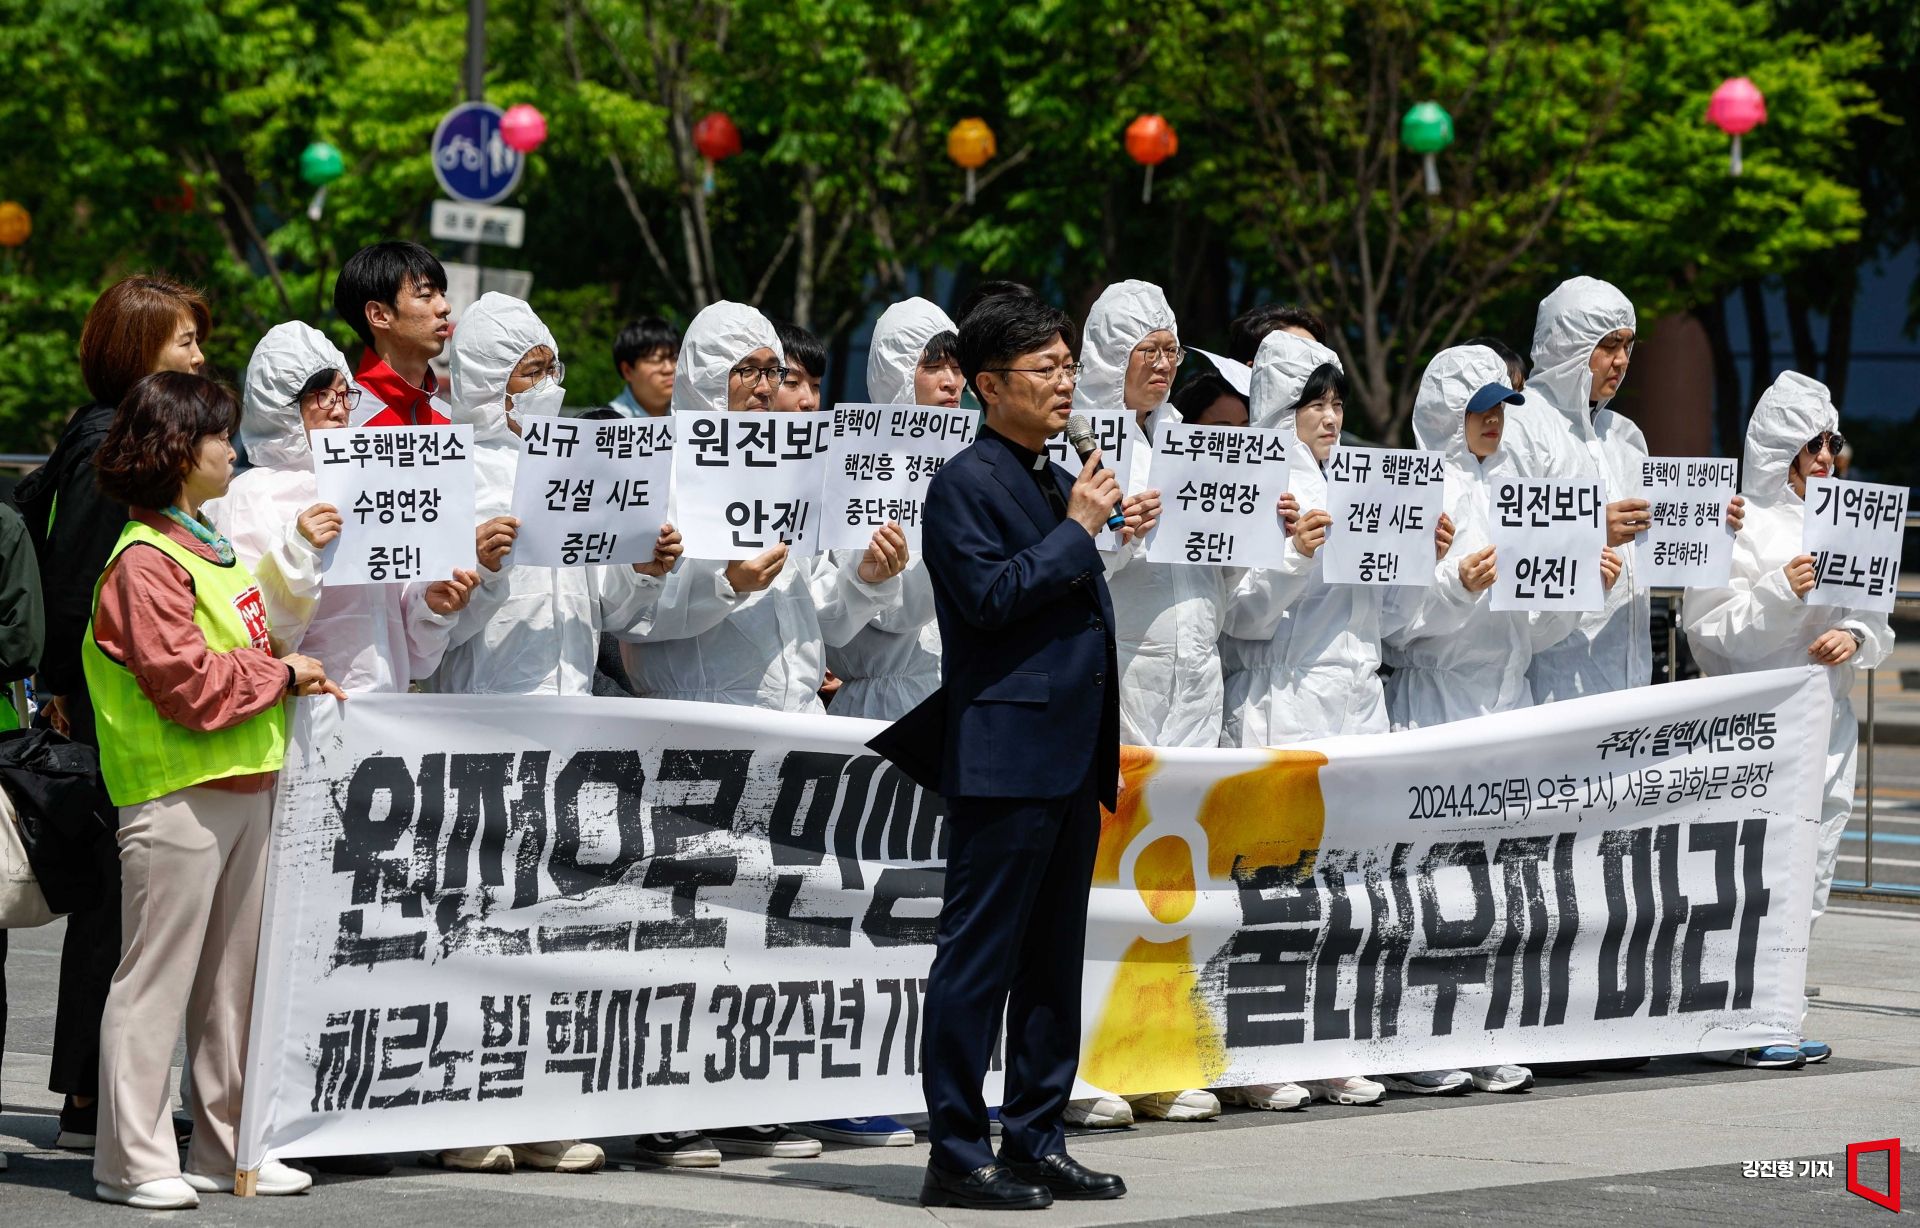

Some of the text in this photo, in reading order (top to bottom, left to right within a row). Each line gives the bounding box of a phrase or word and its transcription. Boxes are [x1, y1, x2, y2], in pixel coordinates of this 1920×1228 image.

[525, 423, 672, 458] 신규 핵발전소
[832, 408, 973, 443] 탈핵이 민생이다,
[324, 432, 465, 468] 노후핵발전소
[1161, 430, 1285, 464] 노후핵발전소
[845, 454, 894, 481] 핵진흥
[1331, 453, 1443, 485] 신규 핵발전소
[1643, 462, 1738, 490] 탈핵이 민생이다,
[353, 488, 441, 524] 수명연장
[546, 479, 649, 512] 건설 시도
[1177, 481, 1259, 514] 수명연장
[1497, 484, 1601, 528] 원전보다
[1816, 485, 1902, 532] 기억하라
[726, 499, 809, 547] 안전!
[1348, 503, 1423, 533] 건설 시도
[1654, 503, 1720, 527] 핵진흥 정책
[368, 545, 420, 580] 중단!
[561, 532, 616, 564] 중단!
[1185, 532, 1233, 562] 중단!
[1654, 542, 1707, 565] 중단하라!
[1359, 553, 1398, 581] 중단!
[1516, 556, 1577, 598] 안전!
[1597, 713, 1776, 760] 주최: 탈핵시민행동
[1409, 762, 1773, 821] 2024.4.25(목) 오후 1시, 서울 광화문 광장
[332, 749, 754, 966] 원전으로
[1226, 819, 1770, 1048] 불태우지 마라
[311, 994, 531, 1112] 체르노빌
[546, 983, 696, 1094] 핵사고
[704, 978, 865, 1082] 38주년
